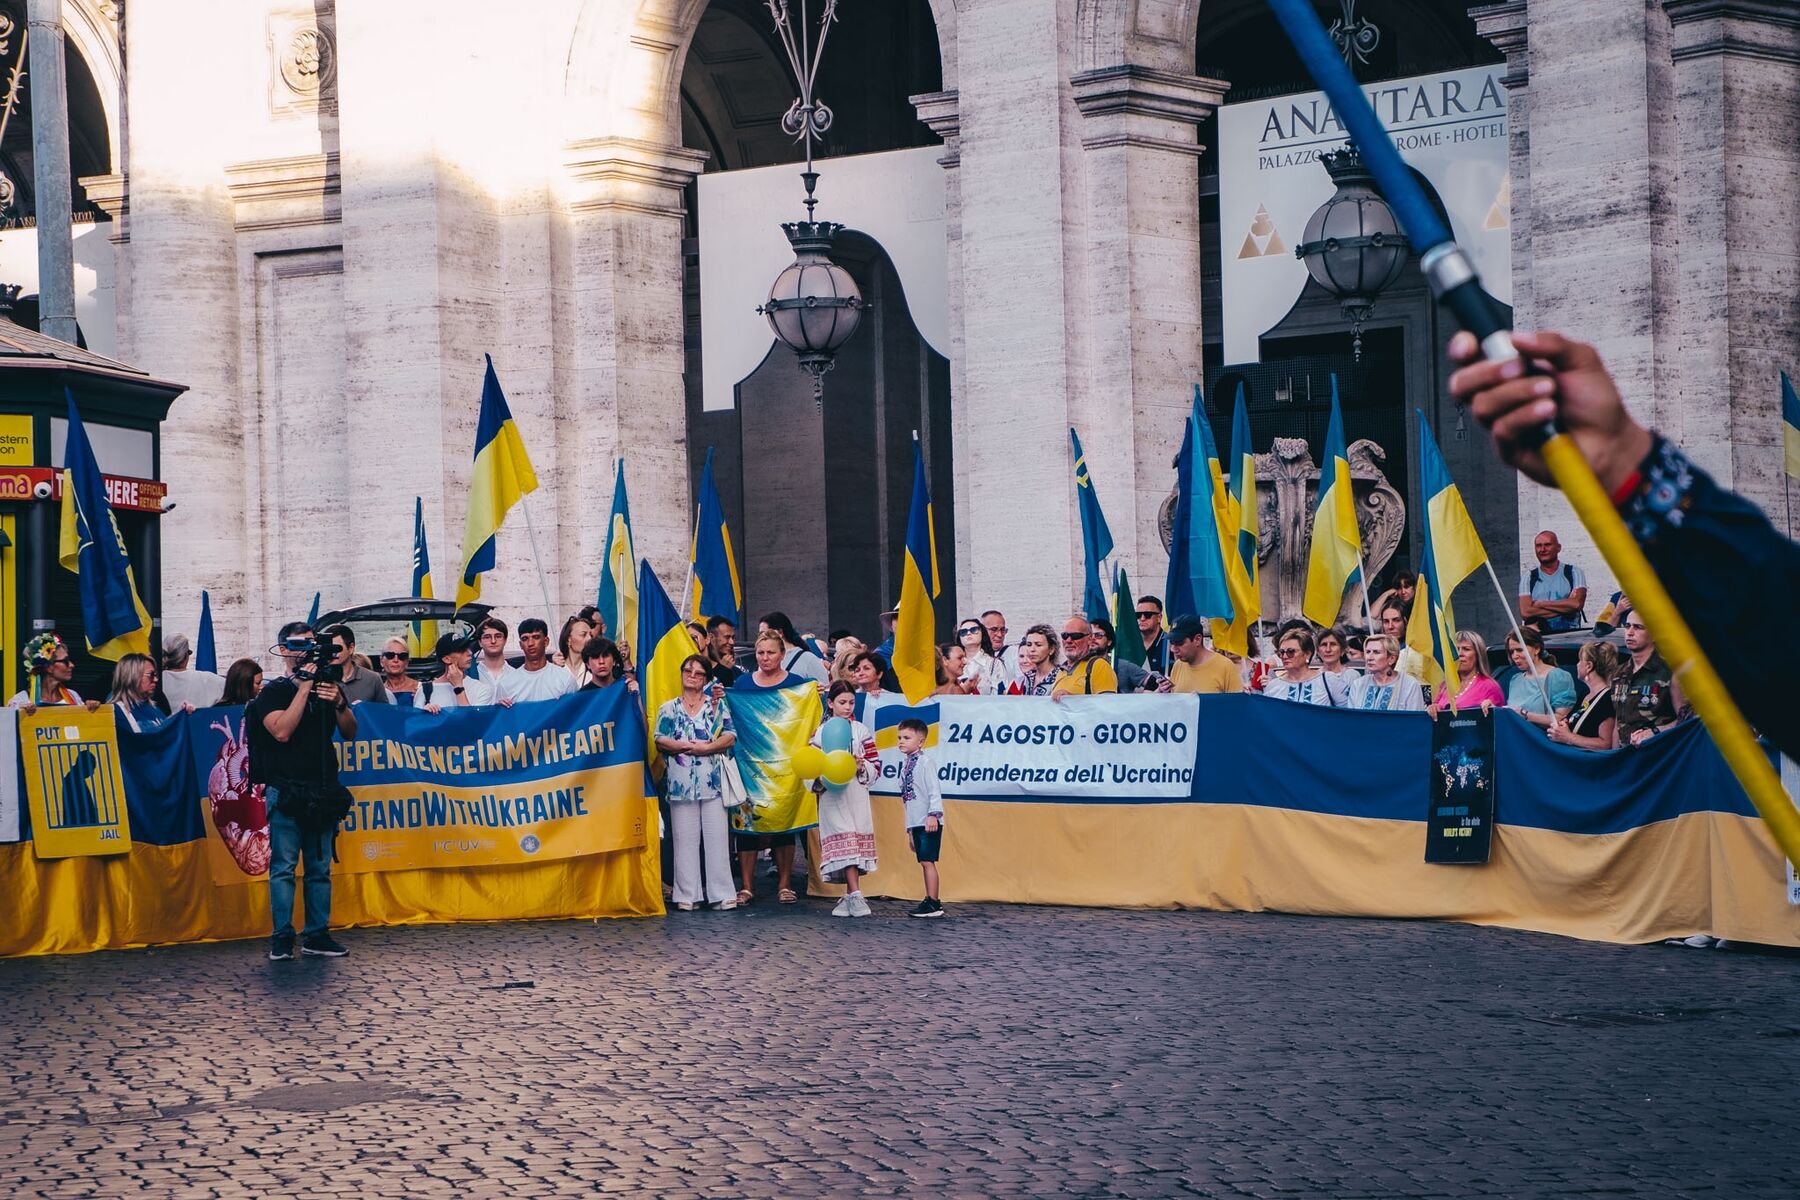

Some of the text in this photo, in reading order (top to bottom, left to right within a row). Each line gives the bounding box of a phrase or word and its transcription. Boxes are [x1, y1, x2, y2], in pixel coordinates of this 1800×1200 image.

[1396, 131, 1441, 151] ROME
[1453, 122, 1506, 144] HOTEL
[105, 478, 138, 506] HERE
[35, 726, 60, 741] PUT
[947, 723, 973, 743] 24
[979, 724, 1075, 745] AGOSTO
[1093, 722, 1187, 744] GIORNO
[100, 829, 121, 840] JAIL
